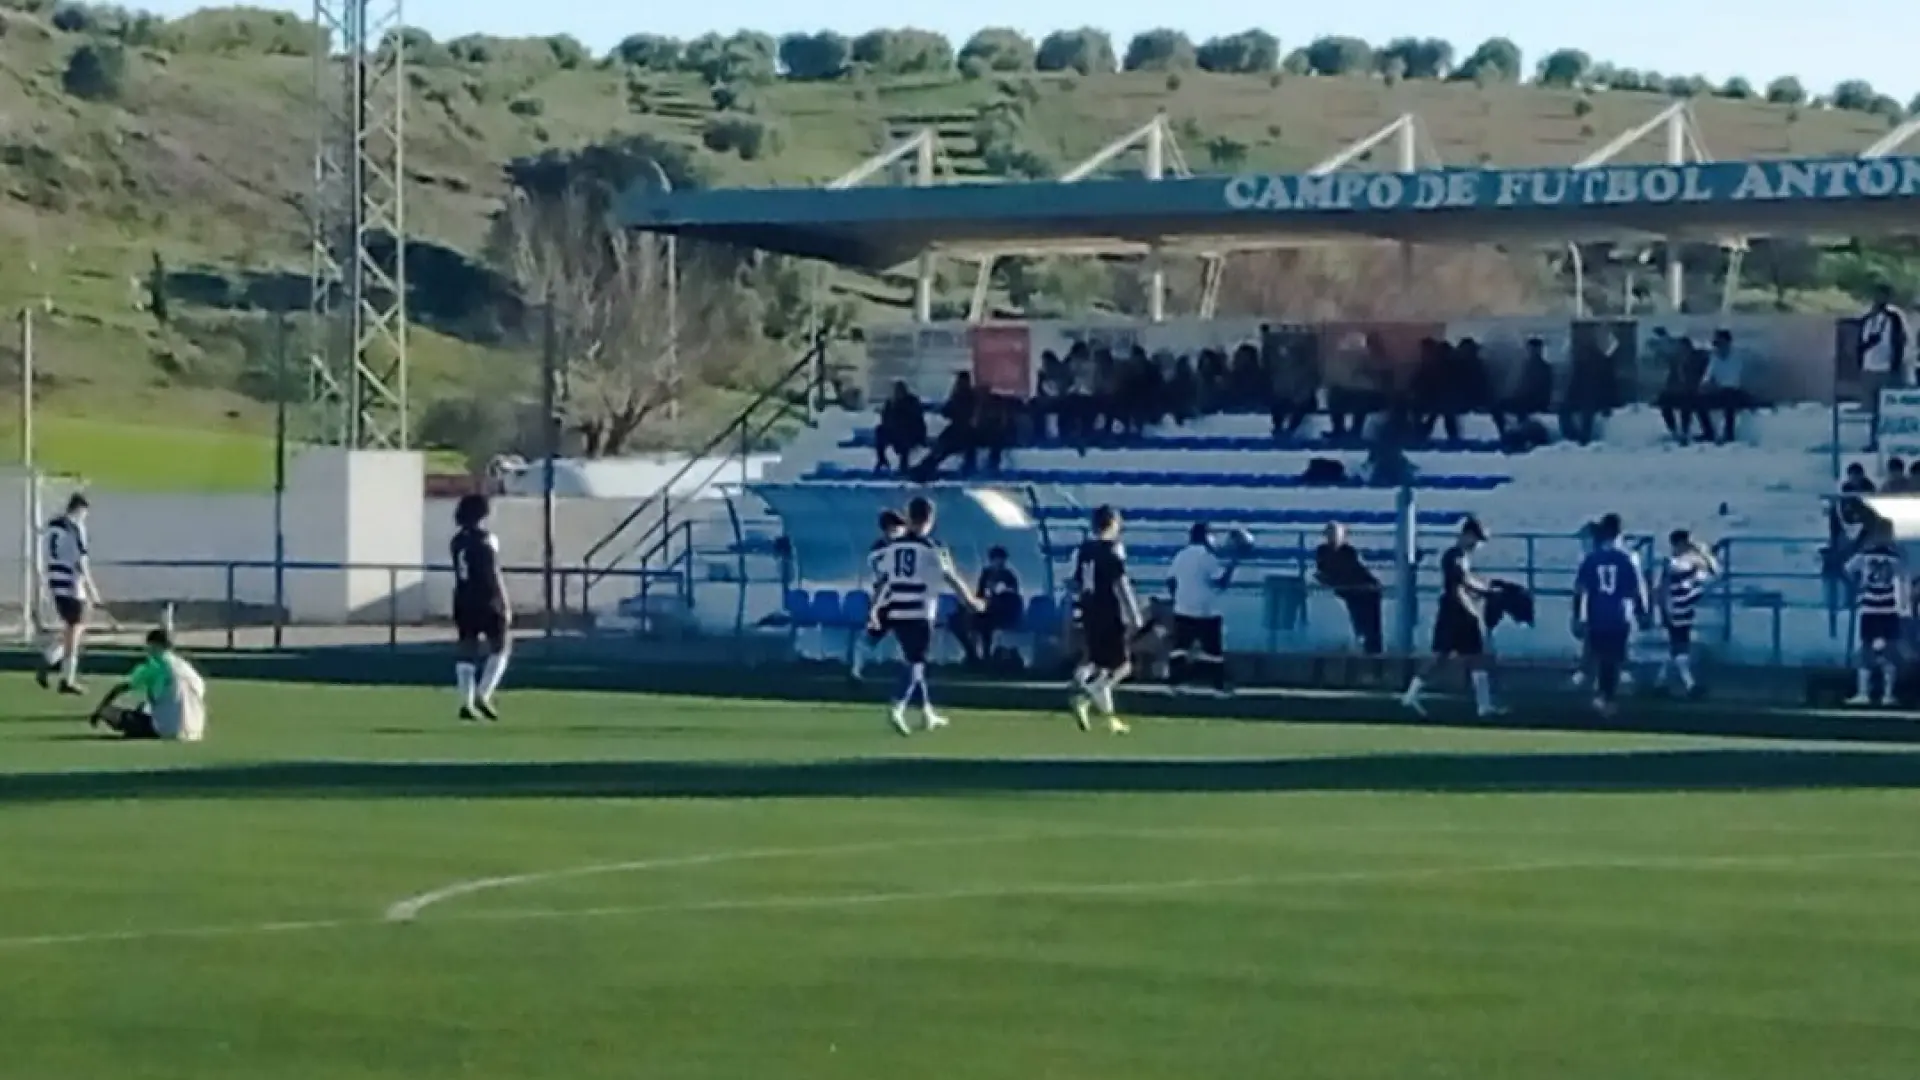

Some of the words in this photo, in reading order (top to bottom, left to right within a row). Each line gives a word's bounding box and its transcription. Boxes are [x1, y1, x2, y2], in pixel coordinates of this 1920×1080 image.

[1224, 172, 1403, 210] CAMPO
[1414, 171, 1480, 209] DE
[1495, 166, 1712, 206] FUTBOL
[894, 548, 917, 578] 19
